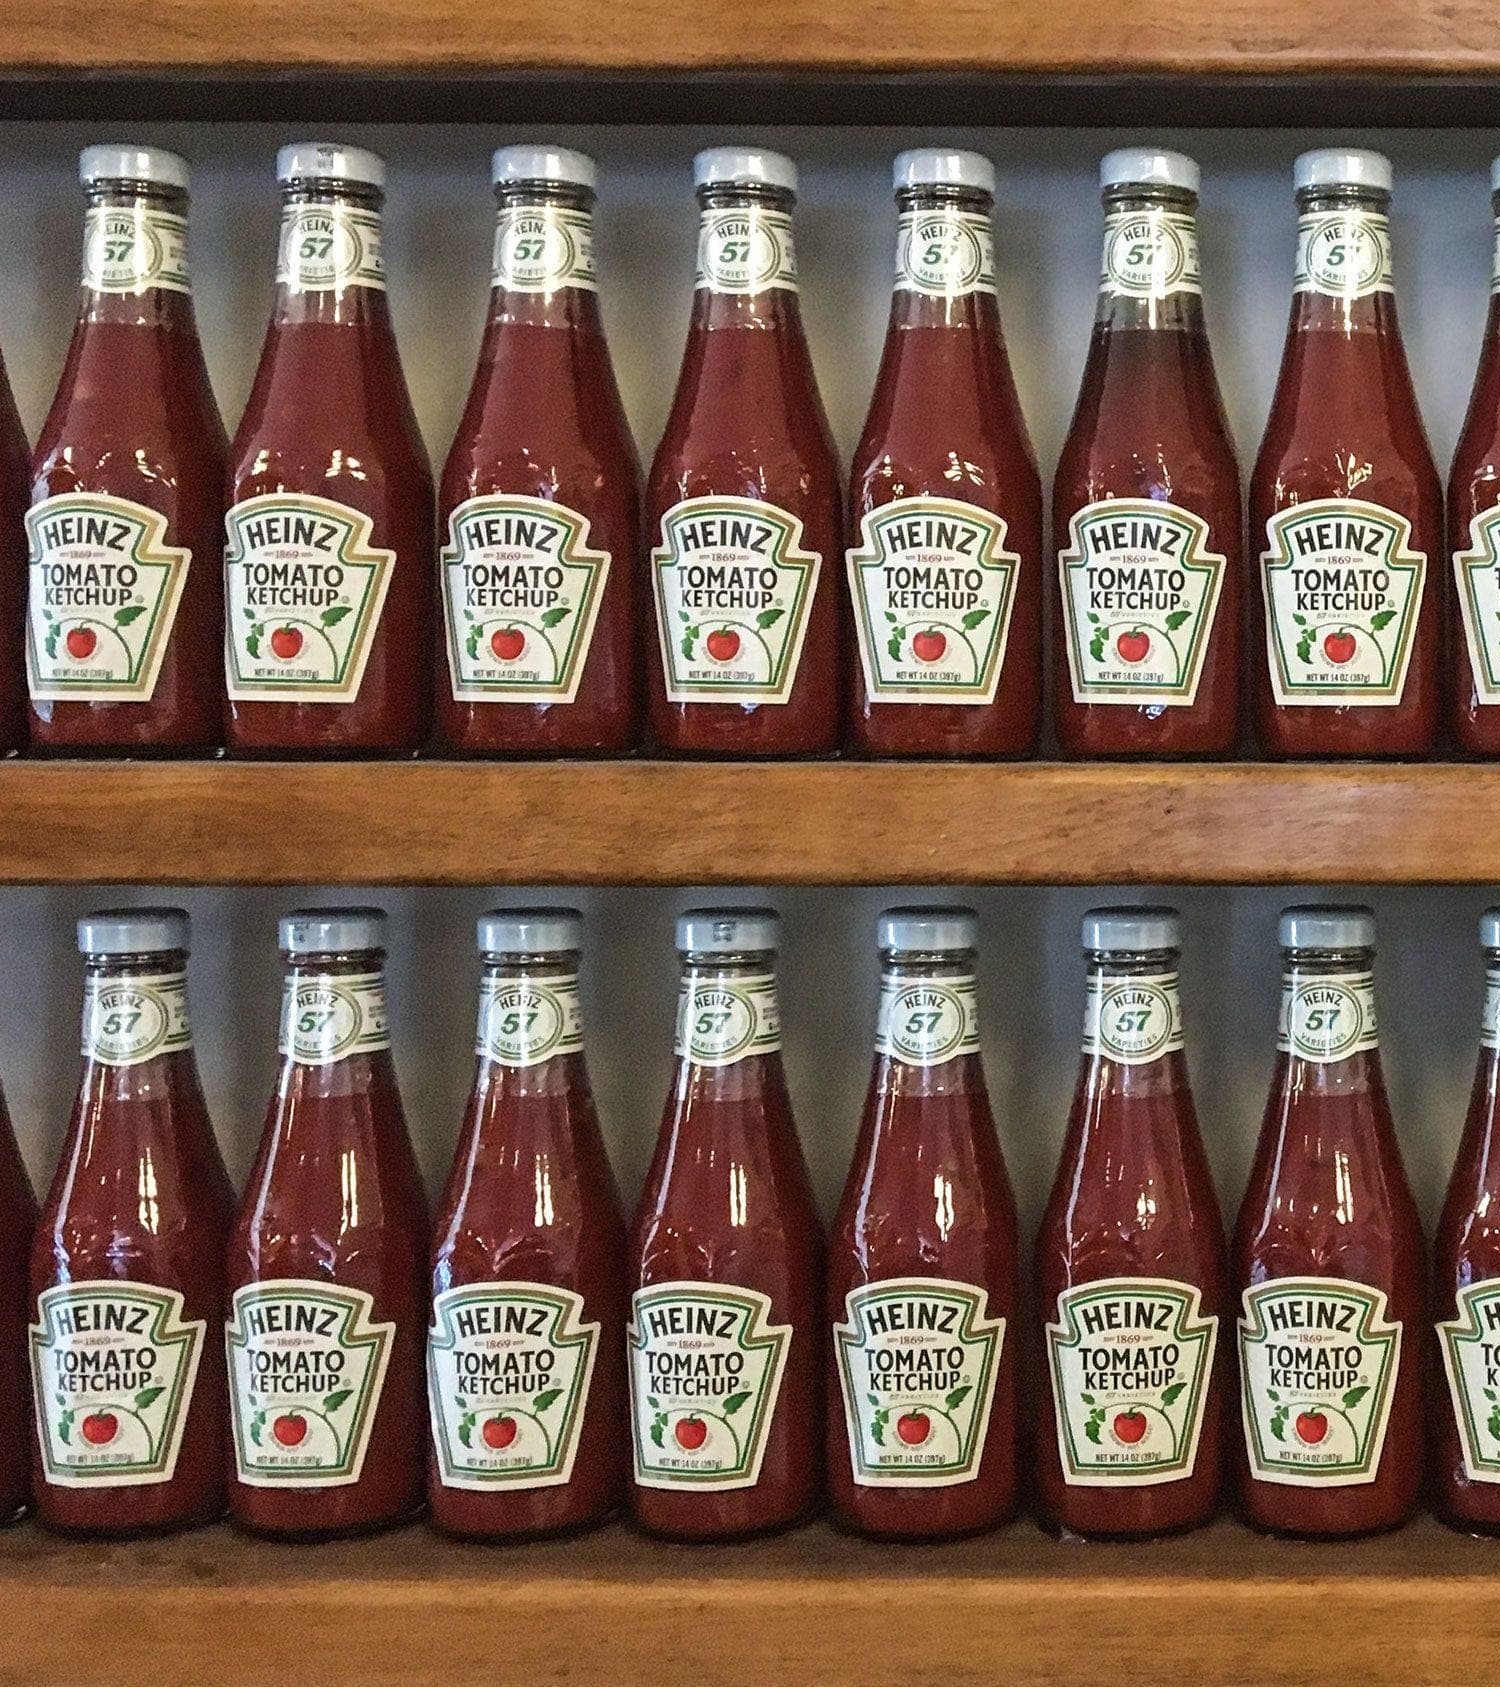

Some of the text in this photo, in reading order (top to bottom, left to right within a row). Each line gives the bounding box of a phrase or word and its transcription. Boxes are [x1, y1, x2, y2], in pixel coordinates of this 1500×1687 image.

[104, 241, 134, 262] 57
[300, 237, 333, 259] 57
[513, 239, 545, 260] 57
[719, 242, 751, 262] 57
[43, 516, 132, 552] HEINZ
[245, 516, 339, 553] HEINZ
[465, 518, 559, 554] HEINZ
[679, 519, 773, 556] HEINZ
[886, 520, 978, 556] HEINZ
[1089, 521, 1182, 557] HEINZ
[1294, 522, 1385, 557] HEINZ
[1328, 556, 1350, 564] 1869
[41, 563, 138, 588] TOMATO
[242, 562, 344, 588] TOMATO
[462, 564, 564, 590] TOMATO
[677, 565, 778, 591] TOMATO
[882, 566, 983, 592] TOMATO
[1086, 567, 1186, 593] TOMATO
[1290, 568, 1390, 592] TOMATO
[45, 587, 133, 607] KETCHUP
[247, 586, 339, 607] KETCHUP
[466, 587, 559, 608] KETCHUP
[681, 589, 774, 609] KETCHUP
[888, 590, 979, 610] KETCHUP
[1090, 590, 1181, 611] KETCHUP
[1296, 592, 1386, 611] KETCHUP
[695, 996, 735, 1009] HEINZ
[904, 995, 946, 1008] HEINZ
[1114, 995, 1154, 1008] HEINZ
[1303, 992, 1342, 1006] HEINZ
[103, 1012, 142, 1033] 57
[298, 1011, 335, 1033] 57
[501, 1012, 538, 1033] 57
[696, 1012, 731, 1033] 57
[906, 1012, 943, 1033] 57
[1116, 1010, 1152, 1032] 57
[1306, 1009, 1340, 1030] 57
[56, 1303, 150, 1336] HEINZ
[248, 1304, 339, 1338] HEINZ
[455, 1306, 549, 1339] HEINZ
[648, 1306, 741, 1339] HEINZ
[865, 1301, 959, 1337] HEINZ
[1080, 1301, 1174, 1335] HEINZ
[1267, 1300, 1357, 1334] HEINZ
[1116, 1335, 1140, 1343] 1869
[54, 1346, 157, 1374] TOMATO
[246, 1348, 346, 1374] TOMATO
[452, 1348, 556, 1377] TOMATO
[645, 1350, 745, 1377] TOMATO
[864, 1345, 965, 1373] TOMATO
[1077, 1343, 1180, 1372] TOMATO
[1264, 1343, 1363, 1371] TOMATO
[58, 1370, 152, 1393] KETCHUP
[250, 1373, 341, 1394] KETCHUP
[458, 1372, 551, 1396] KETCHUP
[650, 1375, 740, 1397] KETCHUP
[870, 1370, 961, 1392] KETCHUP
[1084, 1367, 1176, 1391] KETCHUP
[1270, 1368, 1359, 1391] KETCHUP
[1096, 1454, 1108, 1462] NET
[1110, 1454, 1120, 1462] WT
[1122, 1454, 1129, 1462] 14
